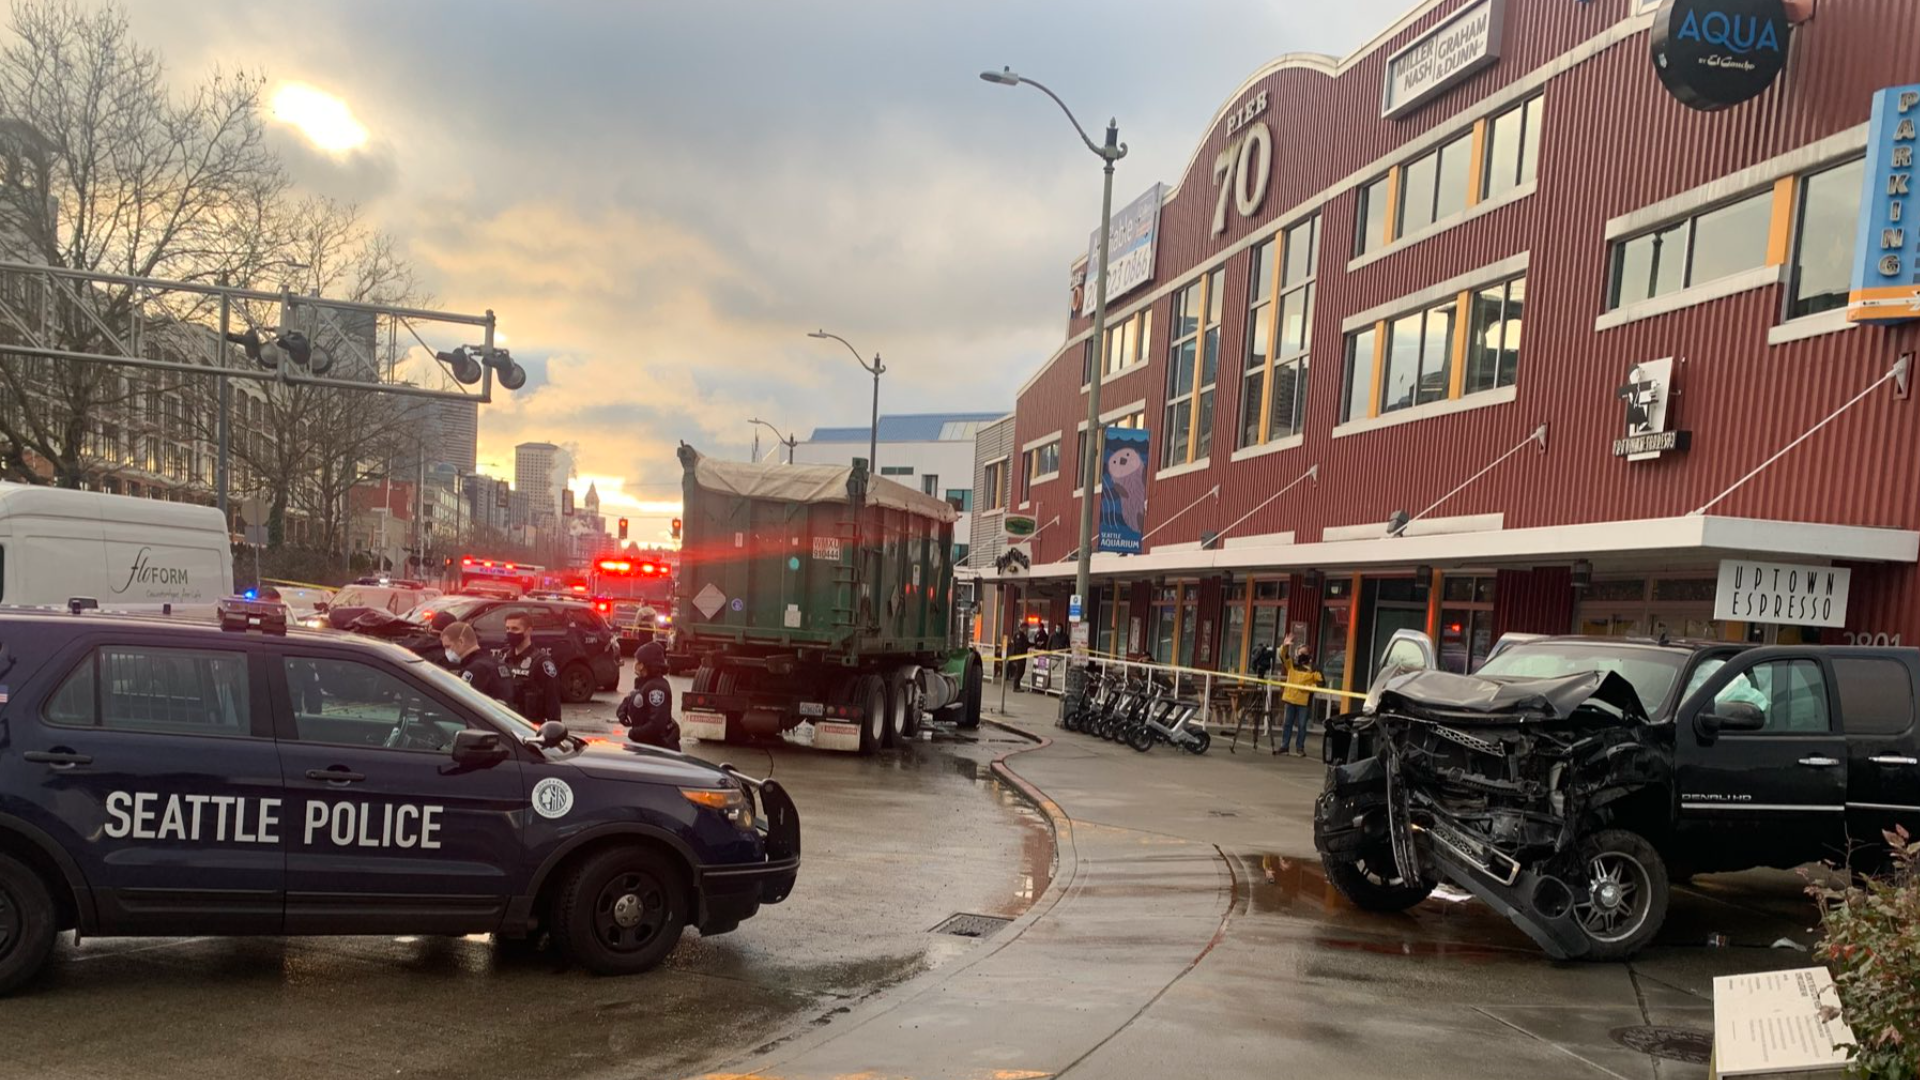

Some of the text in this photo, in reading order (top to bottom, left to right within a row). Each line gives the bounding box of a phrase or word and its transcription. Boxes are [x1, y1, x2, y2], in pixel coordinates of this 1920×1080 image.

[1438, 13, 1487, 59] GRAHAM
[1678, 8, 1779, 54] AQUA
[1396, 39, 1435, 79] MILLER
[1404, 58, 1433, 92] NASH
[1226, 89, 1268, 138] PIER
[1211, 122, 1272, 241] 70
[1878, 92, 1920, 277] PARKING
[813, 536, 840, 549] WMXU
[1100, 539, 1139, 549] AQUARIUM
[1734, 565, 1835, 596] UPTOWN
[1732, 592, 1831, 621] ESPRESSO
[1732, 793, 1752, 801] HD
[104, 790, 444, 849] SEATTLE POLICE
